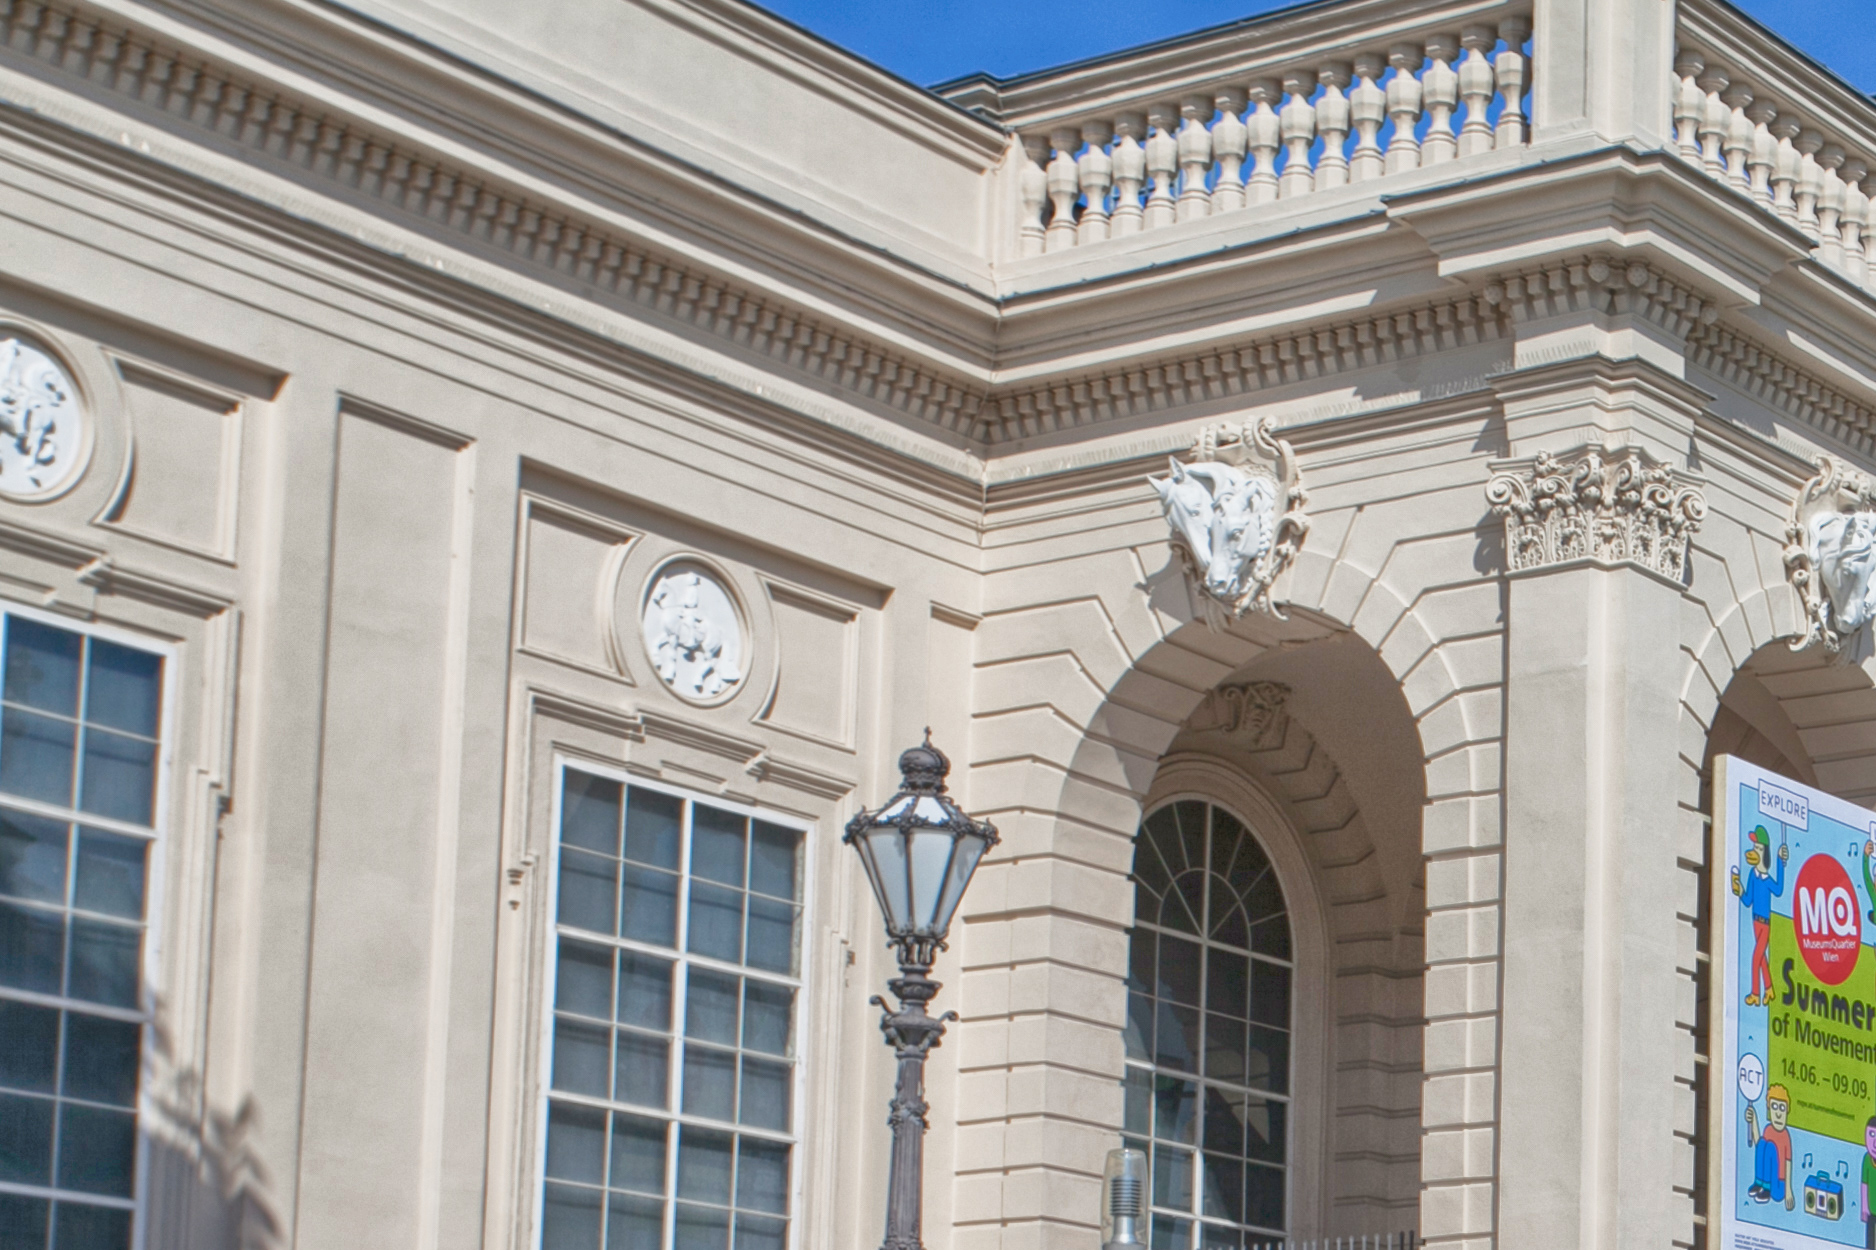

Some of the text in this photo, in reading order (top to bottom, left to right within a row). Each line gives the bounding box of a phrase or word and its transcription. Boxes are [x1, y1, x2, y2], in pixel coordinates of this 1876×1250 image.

[1761, 790, 1806, 820] EXPLORE
[1799, 886, 1857, 936] MQ
[1803, 939, 1856, 949] MuseumsQuartier
[1822, 952, 1839, 962] Wien
[1782, 957, 1876, 1032] Summer
[1772, 1012, 1790, 1039] of
[1740, 1067, 1762, 1086] ACT
